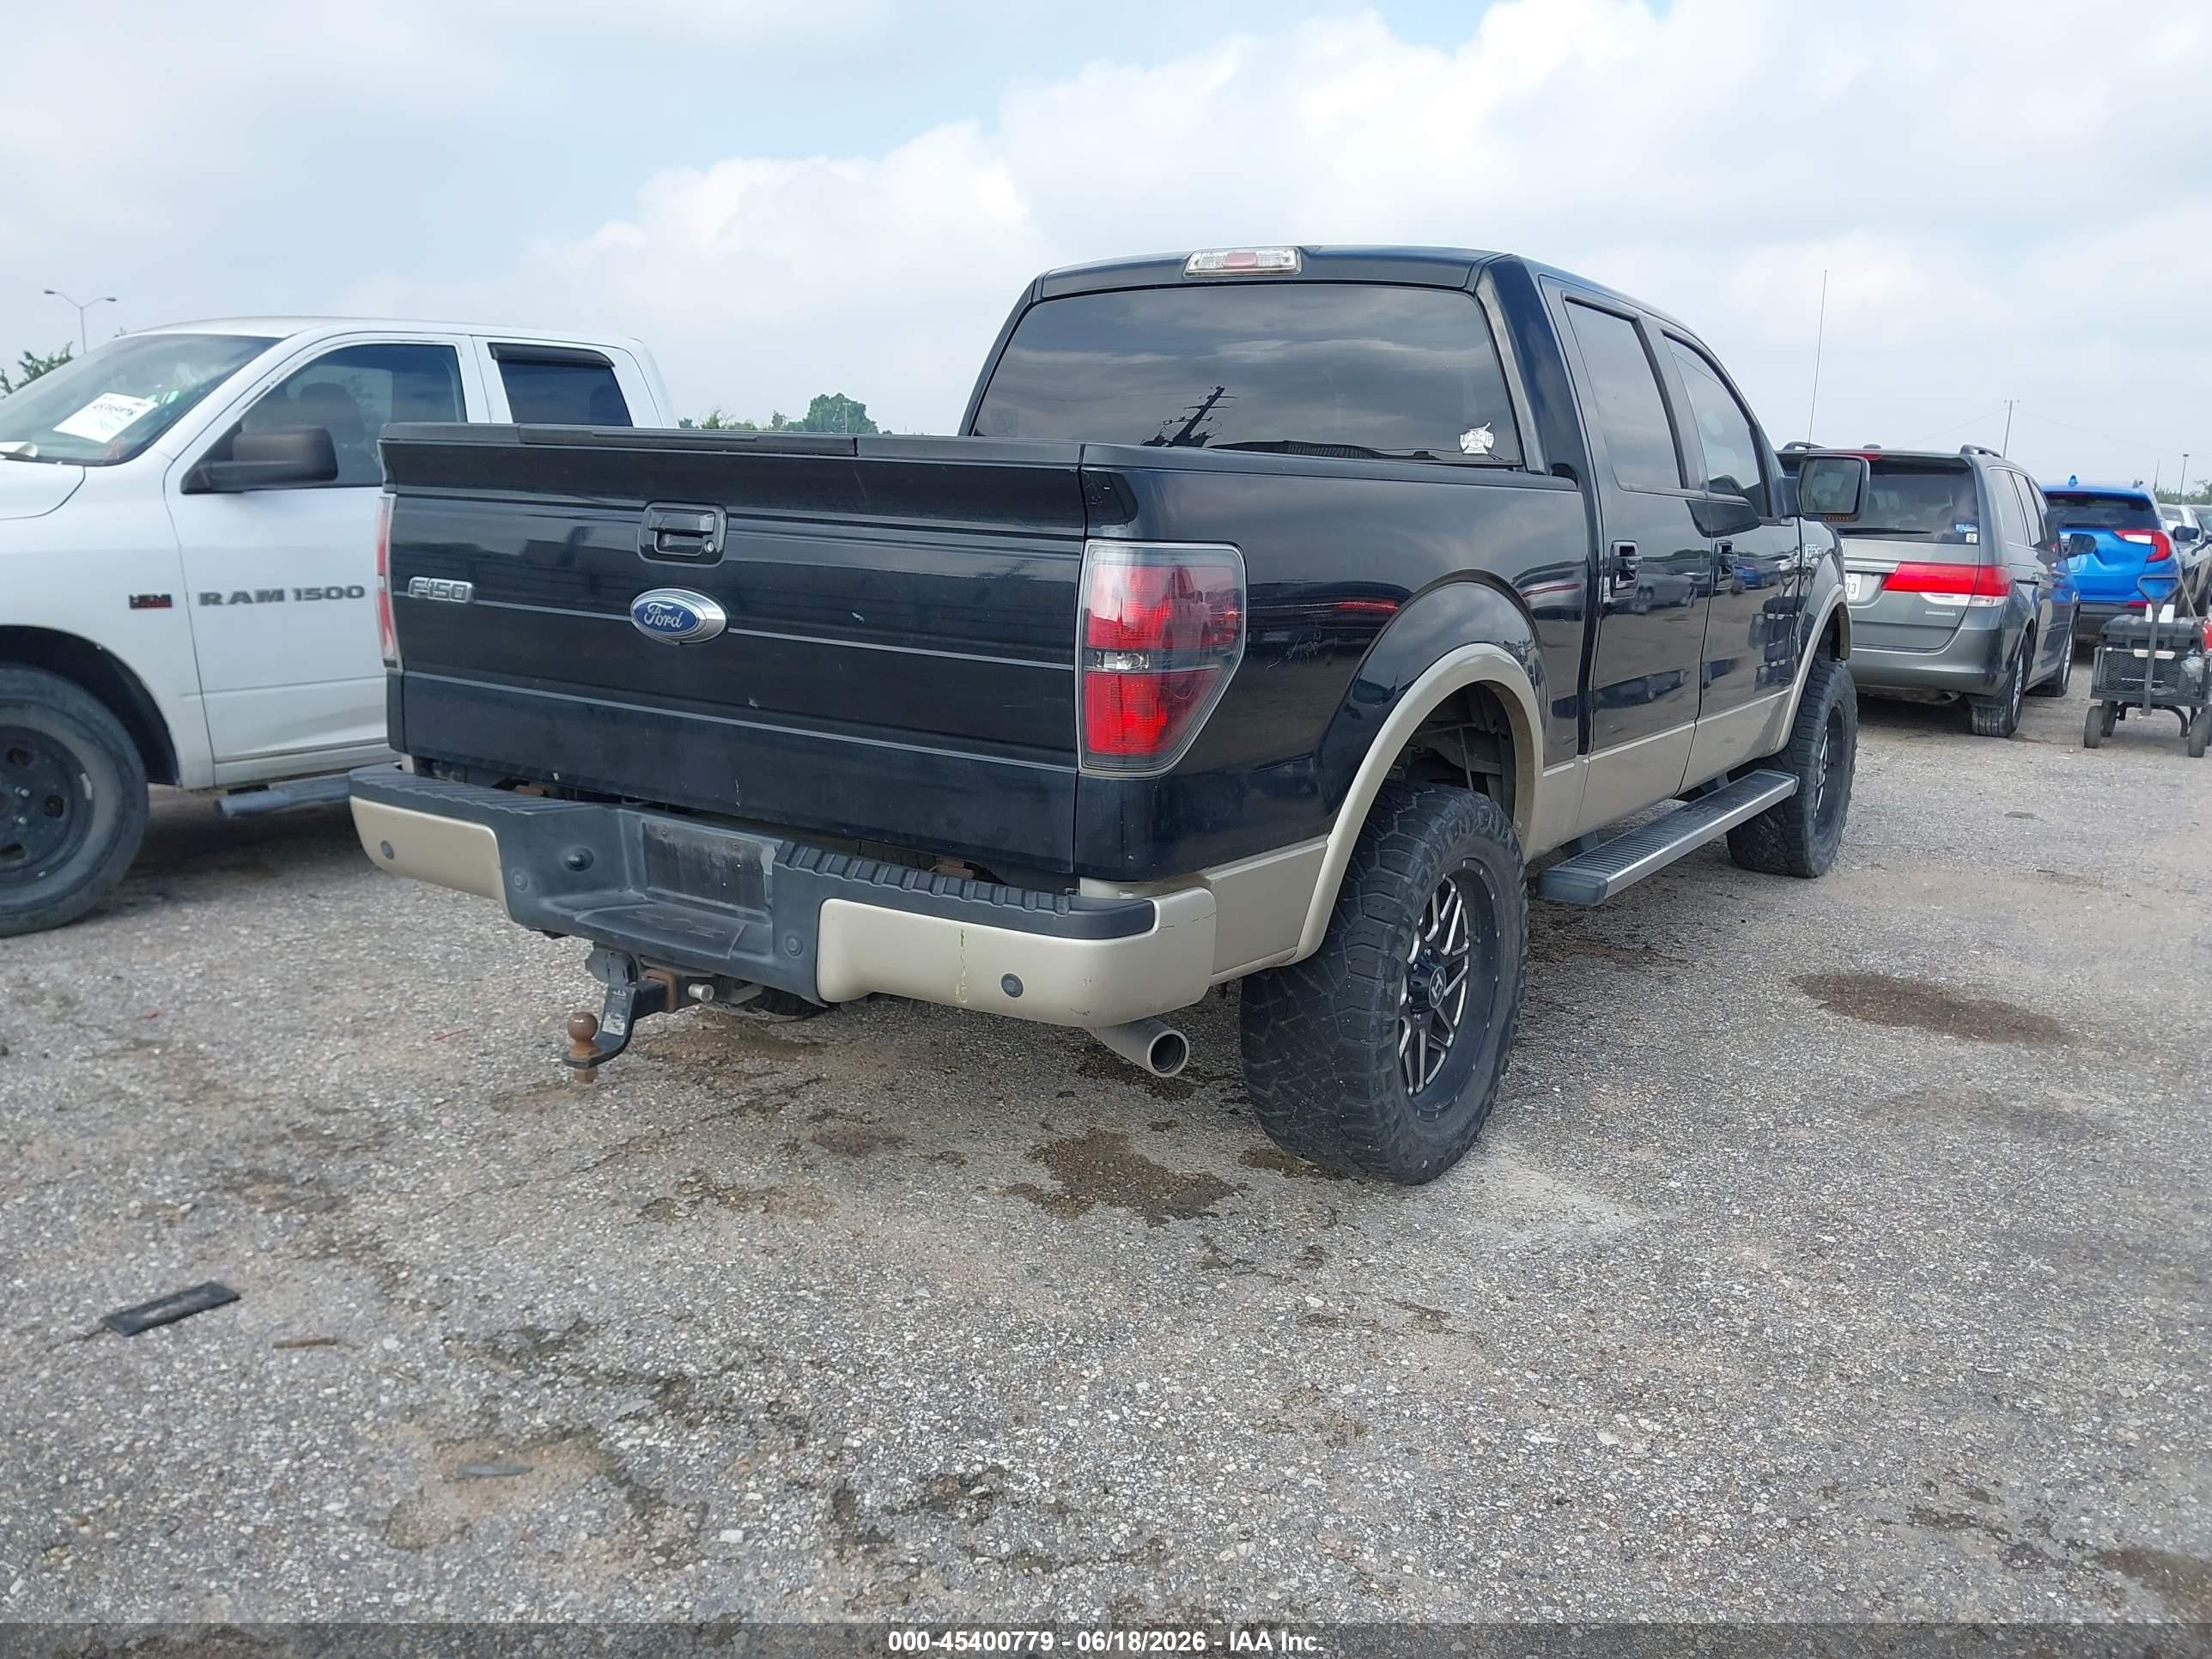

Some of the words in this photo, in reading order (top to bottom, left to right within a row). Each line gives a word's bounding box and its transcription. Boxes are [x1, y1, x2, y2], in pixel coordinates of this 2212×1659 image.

[199, 589, 284, 605] RAM
[292, 586, 365, 600] 1500
[643, 602, 684, 629] Ford
